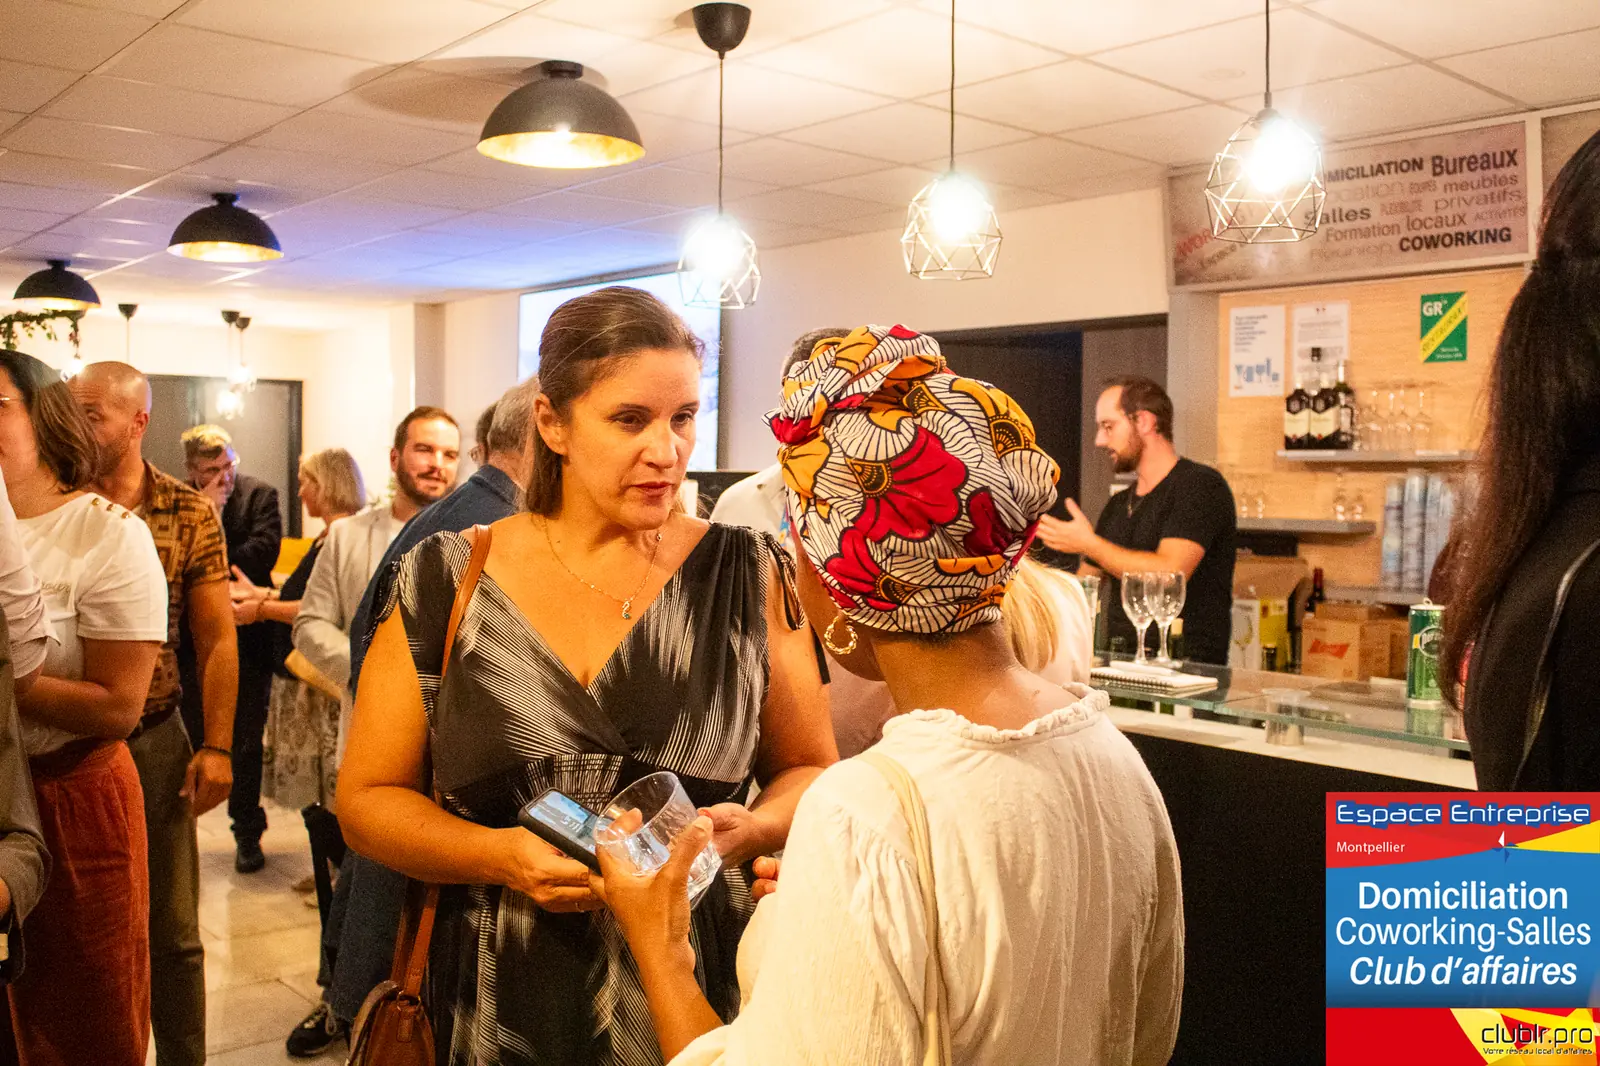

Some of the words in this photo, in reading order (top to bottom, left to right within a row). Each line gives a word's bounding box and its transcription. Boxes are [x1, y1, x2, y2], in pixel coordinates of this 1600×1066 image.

[1326, 157, 1424, 182] MICILIATION
[1431, 148, 1518, 177] Bureaux
[1434, 188, 1523, 213] privatifs
[1304, 206, 1372, 227] Salles
[1326, 222, 1400, 242] Formation
[1406, 211, 1467, 232] locaux
[1398, 227, 1512, 252] COWORKING
